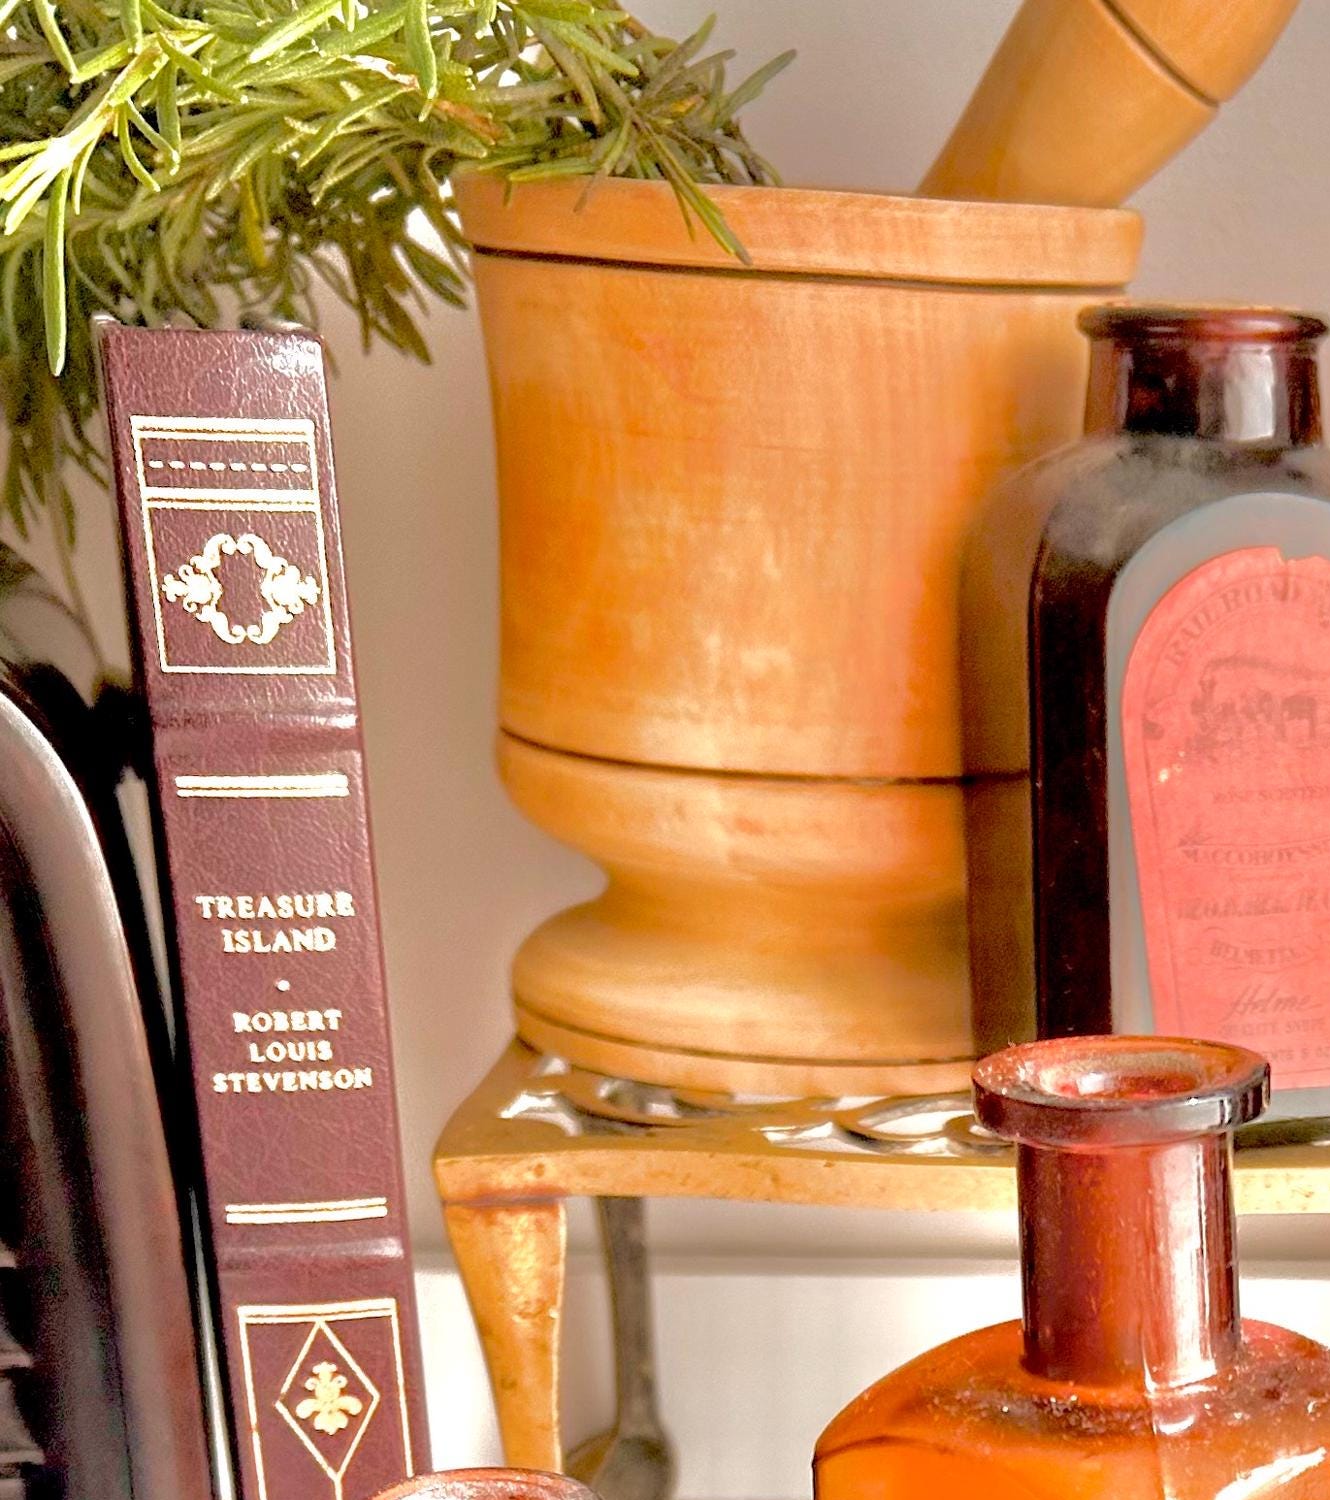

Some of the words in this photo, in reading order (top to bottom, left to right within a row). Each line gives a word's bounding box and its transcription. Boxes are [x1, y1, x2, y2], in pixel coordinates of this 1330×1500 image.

[195, 891, 355, 919] TREASURE
[221, 926, 337, 953] ISLAND
[1219, 983, 1325, 1023] Helme
[232, 1008, 342, 1033] ROBERT
[249, 1040, 333, 1063] LOUIS
[211, 1067, 373, 1094] STEVENSON
